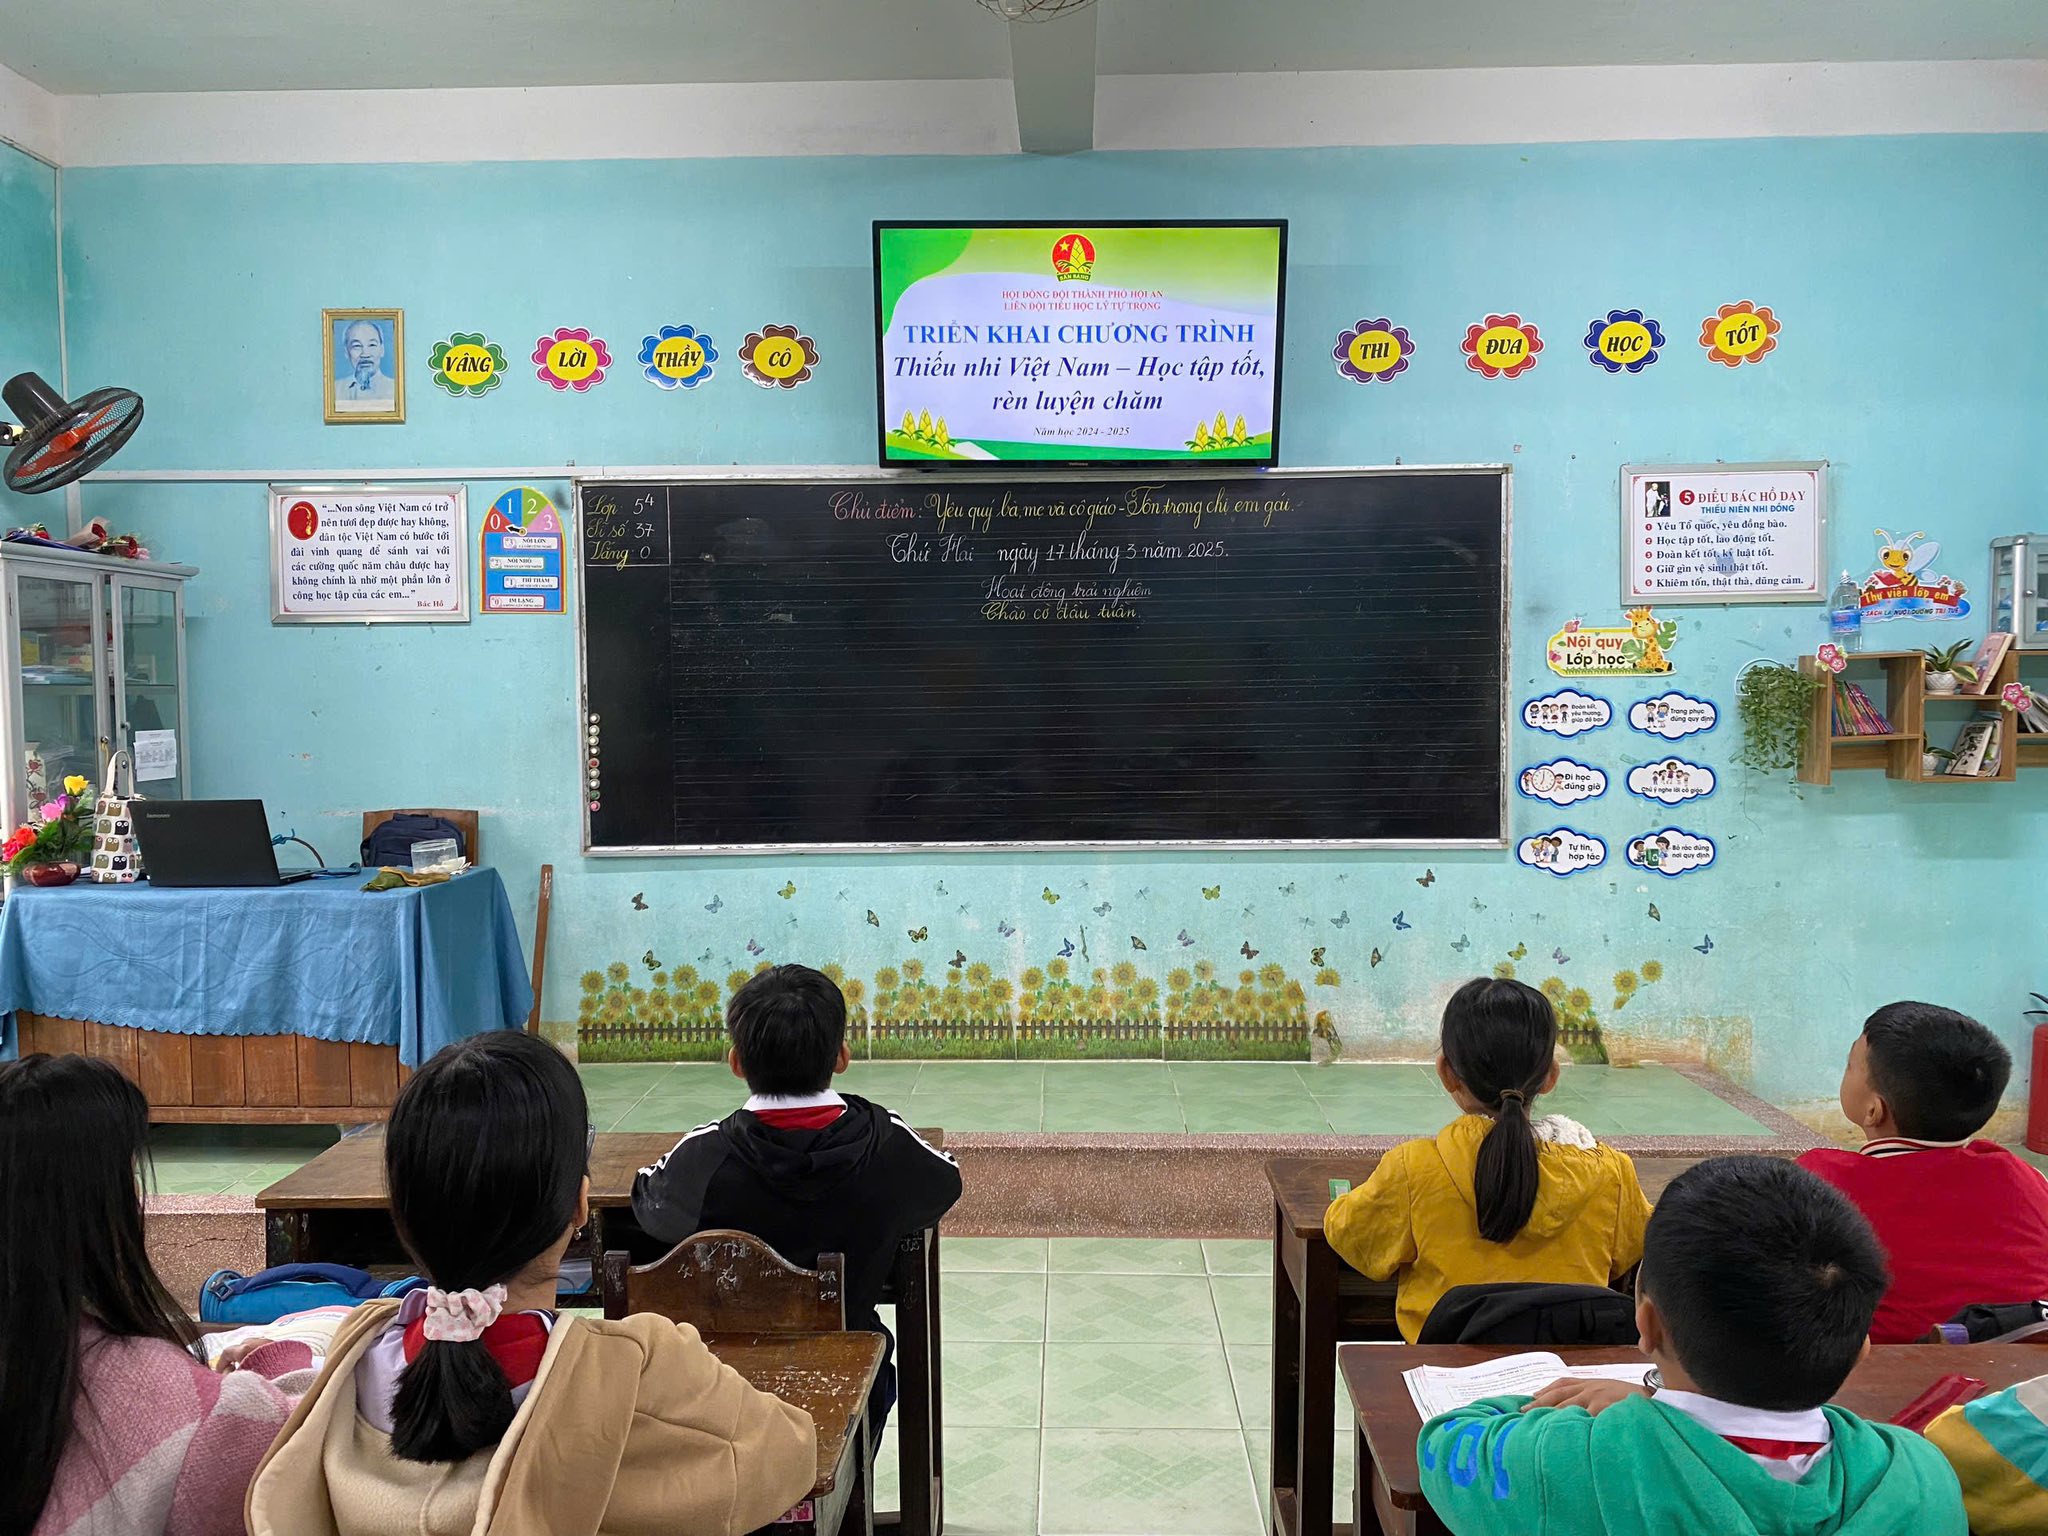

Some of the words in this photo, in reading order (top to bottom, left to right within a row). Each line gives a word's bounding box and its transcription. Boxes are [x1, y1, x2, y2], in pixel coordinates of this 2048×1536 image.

[1151, 290, 1163, 298] AN
[904, 320, 980, 343] TRIỂN
[986, 325, 1050, 343] KHAI
[1058, 322, 1168, 343] CHƯƠNG
[1176, 319, 1255, 343] TRÌNH
[1726, 321, 1760, 347] TỐT
[1359, 343, 1390, 360] THI
[1486, 338, 1524, 356] ĐUA
[1606, 336, 1644, 358] HỌC
[445, 351, 491, 374] VÂNG
[558, 347, 586, 368] LỜI
[655, 344, 702, 369] THẦY
[768, 348, 792, 367] CÔ
[894, 351, 956, 377] Thiếu
[964, 357, 1001, 377] nhi
[1010, 357, 1051, 382] Việt
[1056, 356, 1110, 377] Nam
[1136, 356, 1183, 382] Học
[1190, 356, 1224, 382] tập
[1231, 350, 1265, 380] tốt,
[993, 391, 1027, 410] rèn
[1036, 390, 1094, 415] luyện
[1103, 390, 1163, 410] chăm
[1058, 427, 1074, 438] học
[1076, 427, 1099, 436] 2024
[1108, 427, 1130, 436] 2025
[1699, 488, 1729, 503] ĐIỀU
[1732, 490, 1757, 501] BÁC
[1760, 487, 1776, 501] HỒ
[1780, 491, 1806, 503] DẠY
[355, 504, 375, 514] sông
[378, 504, 396, 514] Việt
[399, 504, 419, 512] Nam
[422, 503, 432, 512] có
[435, 503, 449, 511] trở
[490, 514, 500, 530] 0
[508, 498, 513, 514] 1
[528, 498, 538, 514] 2
[544, 514, 553, 531] 3
[829, 491, 872, 520] Chủ
[924, 493, 964, 533] Yêu
[968, 499, 995, 533] quý
[1069, 499, 1086, 516] cô
[1206, 487, 1228, 516] chị
[1234, 500, 1260, 513] em
[1701, 504, 1726, 514] THIẾU
[1729, 504, 1750, 513] NIÊN
[1753, 505, 1768, 513] NHI
[321, 518, 337, 527] nên
[340, 518, 357, 527] tươi
[359, 517, 376, 529] đẹp
[378, 517, 399, 528] được
[401, 518, 416, 528] hay
[419, 517, 449, 528] không,
[1657, 522, 1676, 531] Yêu
[1694, 520, 1719, 531] quốc,
[1722, 520, 1740, 531] yêu
[1742, 518, 1765, 530] đồng
[1768, 519, 1787, 528] bào.
[319, 533, 336, 542] dân
[339, 533, 352, 543] tộc
[356, 532, 373, 542] Việt
[377, 533, 397, 541] Nam
[400, 532, 410, 541] có
[413, 531, 434, 541] bước
[437, 531, 449, 540] tới
[634, 523, 655, 538] 37
[1656, 536, 1676, 546] Học
[1679, 536, 1694, 546] tập
[1697, 534, 1714, 544] tốt,
[1716, 535, 1730, 544] lao
[1732, 534, 1756, 544] động
[1758, 532, 1775, 542] tốt.
[291, 548, 304, 557] đài
[311, 548, 329, 556] vinh
[337, 549, 362, 557] quang
[370, 545, 381, 555] để
[388, 546, 408, 555] sánh
[416, 547, 429, 555] vai
[436, 546, 450, 555] với
[640, 546, 651, 559] 0
[886, 532, 931, 563] Thứ
[938, 534, 975, 563] Hai
[996, 542, 1039, 574] ngày
[1046, 544, 1065, 561] 17
[1069, 530, 1120, 575] tháng
[1126, 543, 1137, 560] 3
[1142, 540, 1183, 559] năm
[1656, 550, 1683, 559] Đoàn
[1685, 548, 1701, 558] kết
[1703, 548, 1720, 558] tốt,
[1737, 548, 1755, 558] luật
[1758, 547, 1774, 557] tốt.
[292, 562, 305, 571] các
[309, 562, 335, 572] cường
[338, 560, 359, 572] quốc
[362, 562, 381, 570] năm
[385, 561, 406, 570] châu
[409, 561, 431, 572] được
[434, 560, 449, 571] hay
[1656, 564, 1675, 573] Giữ
[1677, 564, 1692, 574] gìn
[1694, 564, 1705, 573] vệ
[1708, 564, 1727, 572] sinh
[1730, 562, 1749, 573] thật
[1752, 561, 1768, 571] tốt.
[292, 576, 319, 587] không
[322, 576, 345, 585] chính
[349, 575, 357, 585] là
[360, 575, 377, 585] nhờ
[381, 576, 397, 586] một
[402, 573, 424, 586] phần
[427, 575, 441, 584] lớn
[445, 574, 451, 584] ở
[1656, 578, 1689, 587] Khiêm
[1692, 577, 1710, 587] tốn,
[1712, 576, 1732, 587] thật
[1734, 577, 1753, 585] thà,
[1755, 576, 1779, 586] dũng
[1782, 575, 1804, 584] cảm.
[293, 591, 313, 601] công
[316, 591, 331, 601] học
[335, 590, 349, 601] tập
[352, 589, 367, 599] của
[371, 590, 385, 599] các
[1864, 592, 1882, 604] Thư
[1935, 592, 1949, 601] em
[1567, 635, 1591, 651] Nội
[1596, 638, 1623, 650] quy
[1567, 653, 1593, 668] Lớp
[1598, 654, 1625, 668] học
[1671, 708, 1688, 716] Trang
[1689, 708, 1705, 717] phục
[1565, 773, 1574, 781] Đi
[1576, 774, 1591, 783] học
[1564, 782, 1586, 792] đúng
[1588, 782, 1601, 792] giờ
[1569, 844, 1580, 852] Tự
[1581, 844, 1593, 852] tin,
[1569, 852, 1585, 862] hợp
[1587, 852, 1601, 860] tác
